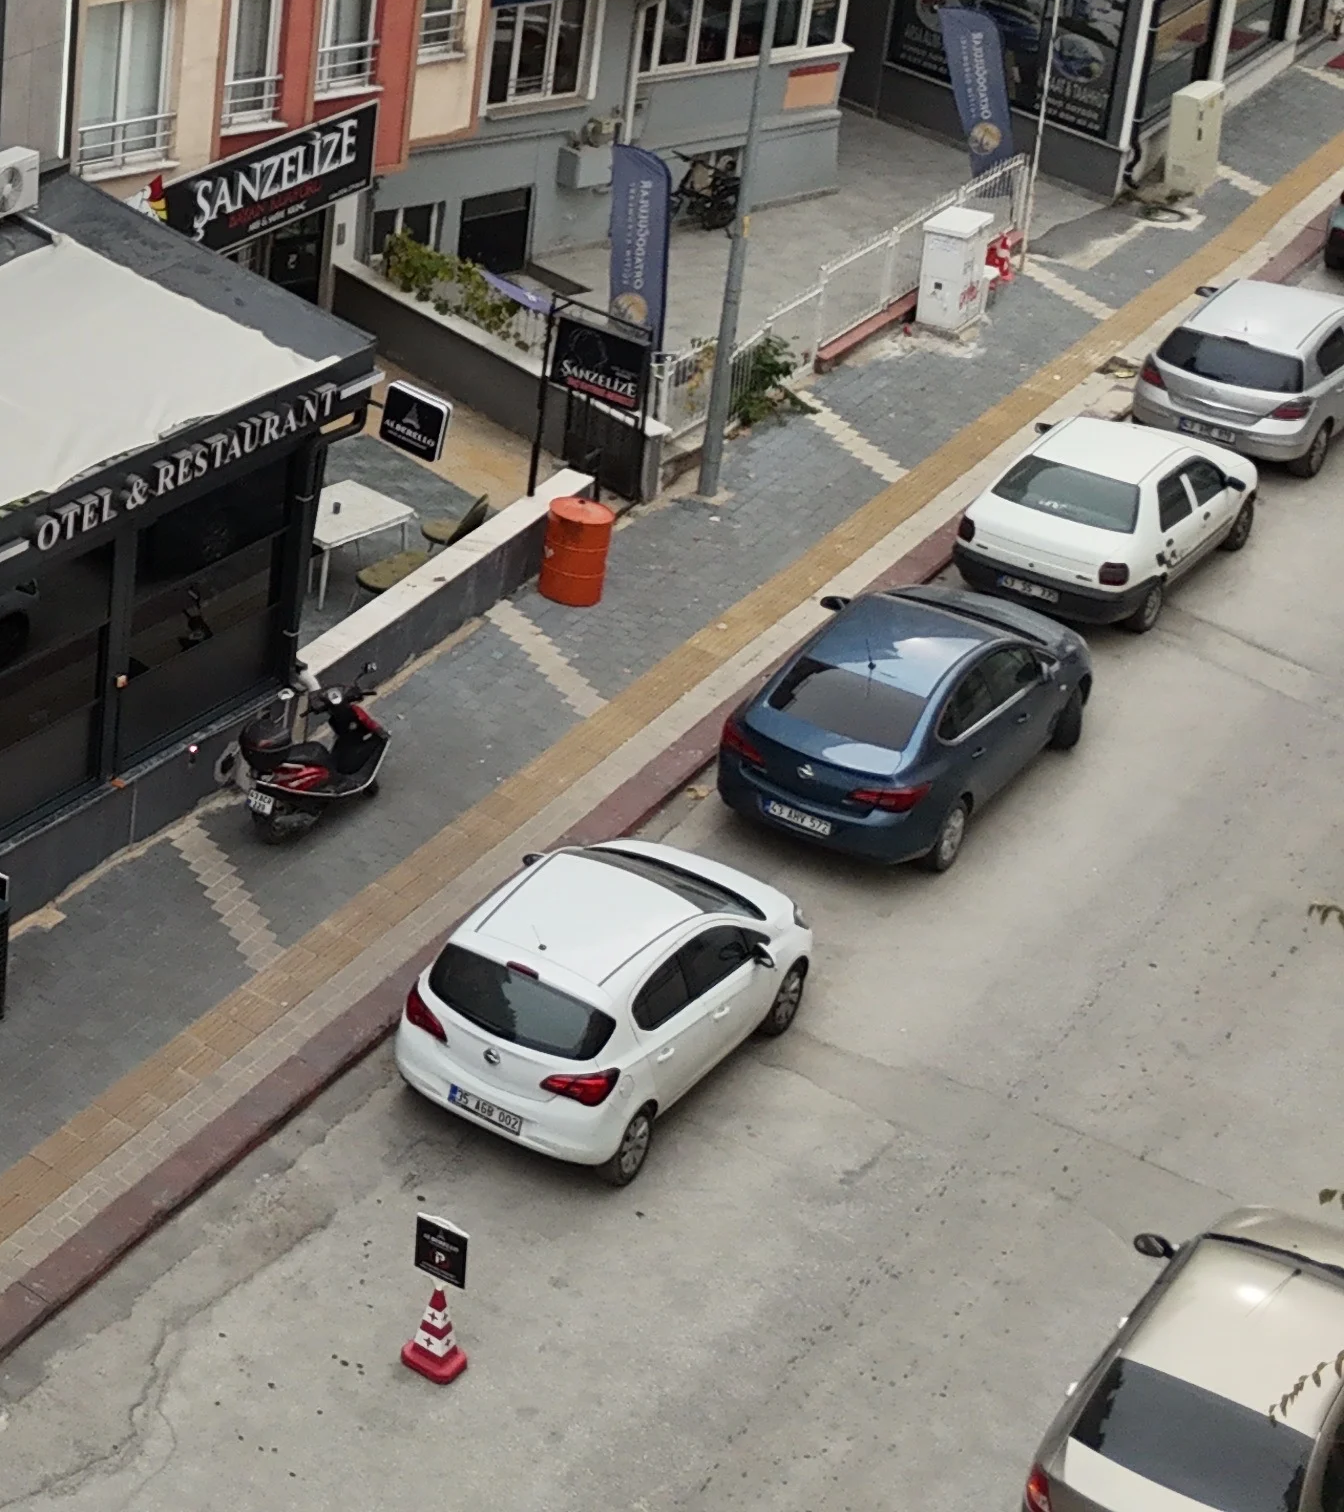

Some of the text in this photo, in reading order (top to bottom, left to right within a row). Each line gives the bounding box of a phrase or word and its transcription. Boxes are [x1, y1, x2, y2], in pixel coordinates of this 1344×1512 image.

[192, 118, 359, 242] ŞANZELİZE
[36, 386, 340, 552] OTEL & RESTAURANT
[770, 801, 784, 815] 43
[456, 1087, 470, 1105] 35
[498, 1110, 519, 1131] 002
